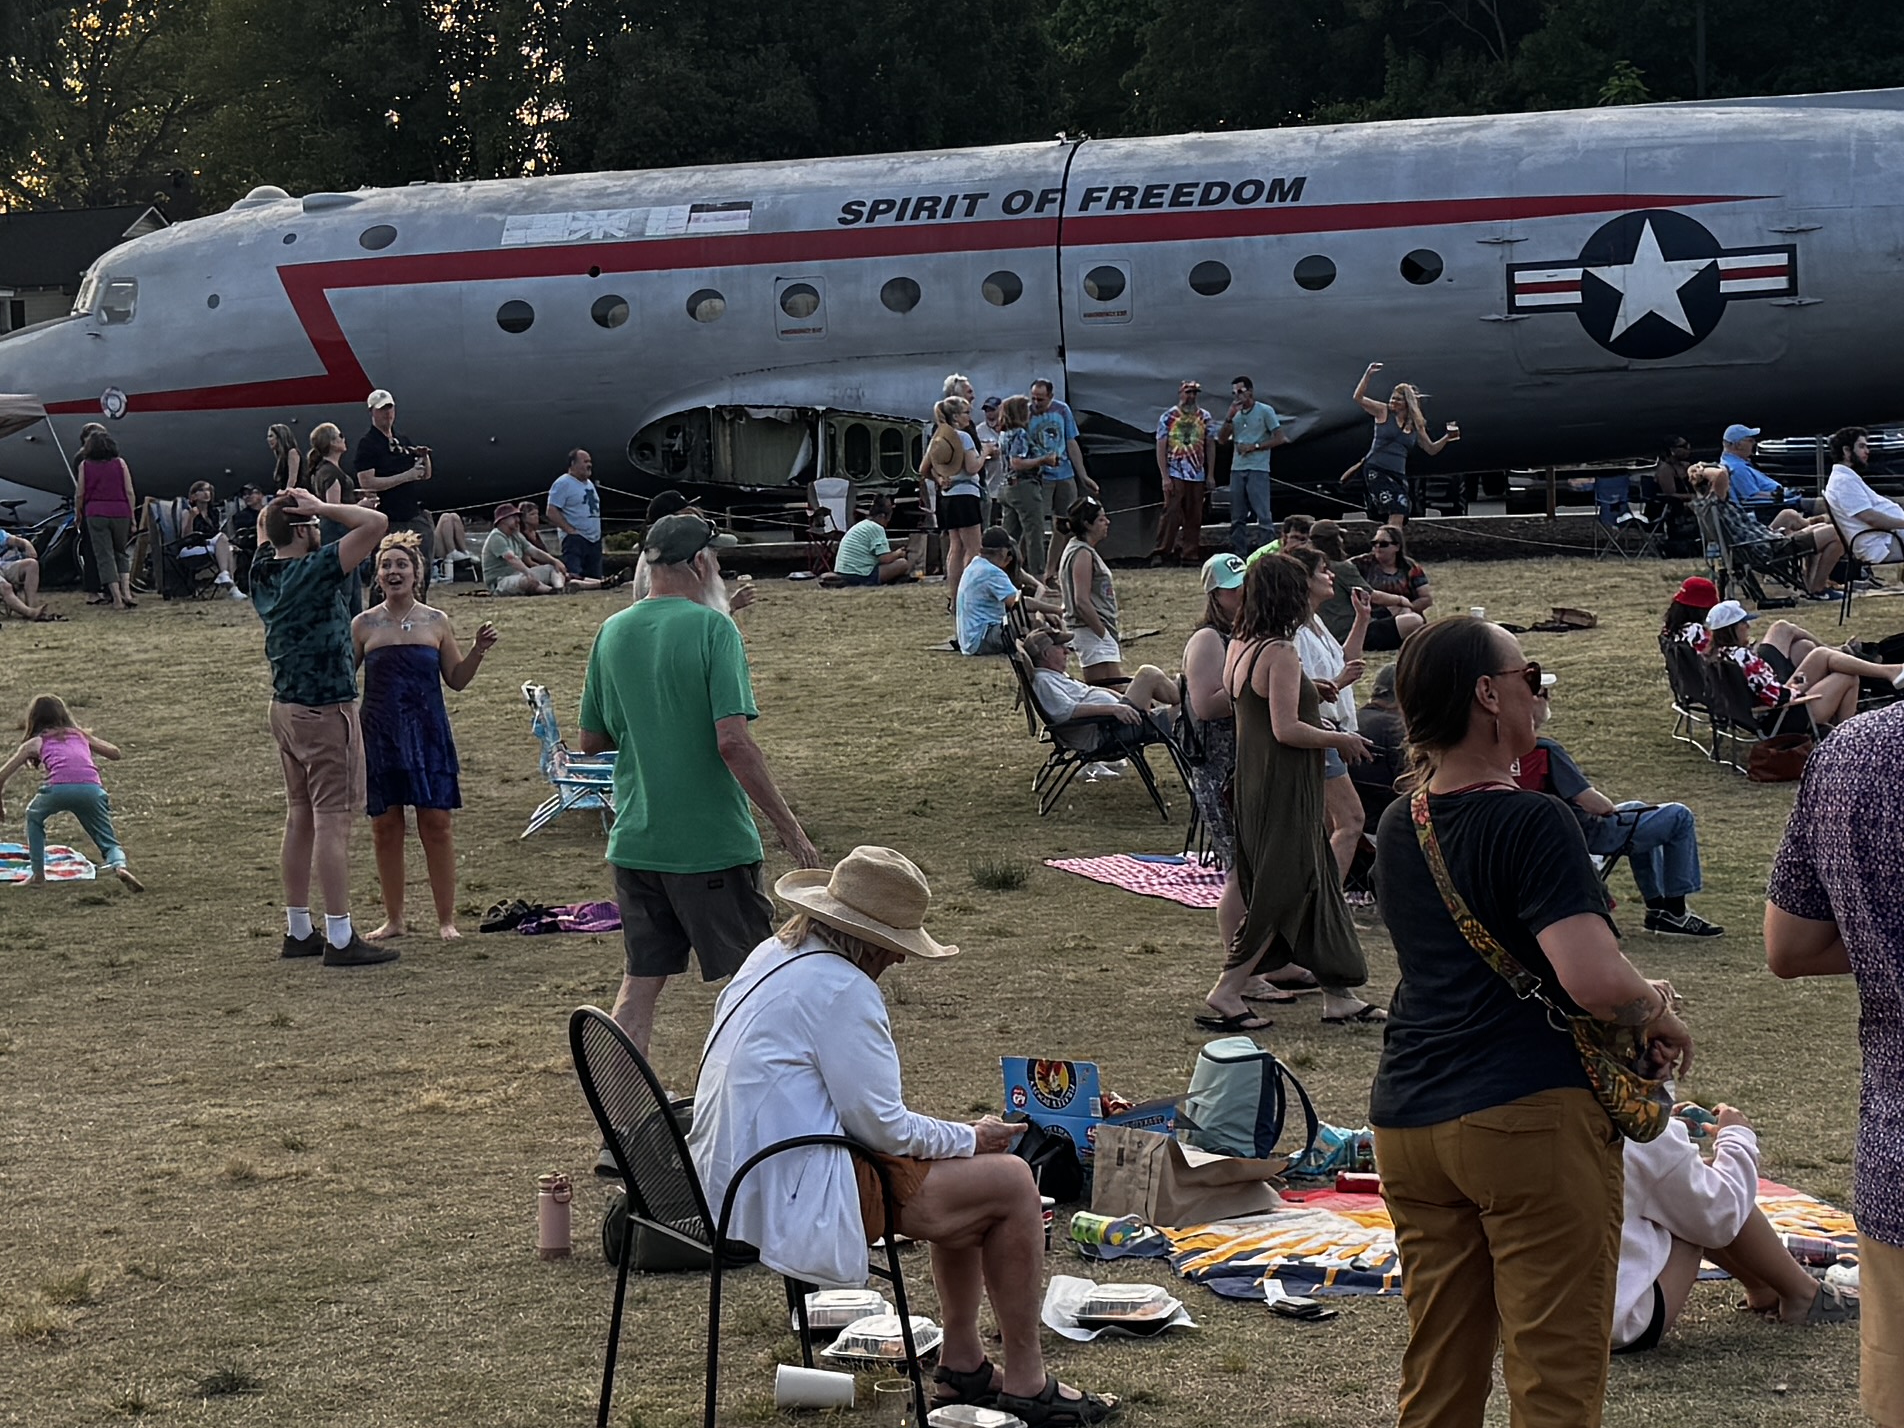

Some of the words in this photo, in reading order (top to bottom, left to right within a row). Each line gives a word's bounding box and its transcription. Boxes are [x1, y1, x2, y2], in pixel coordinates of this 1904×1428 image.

[836, 192, 989, 226] SPIRIT
[1001, 187, 1063, 216] OF
[1078, 176, 1308, 212] FREEDOM
